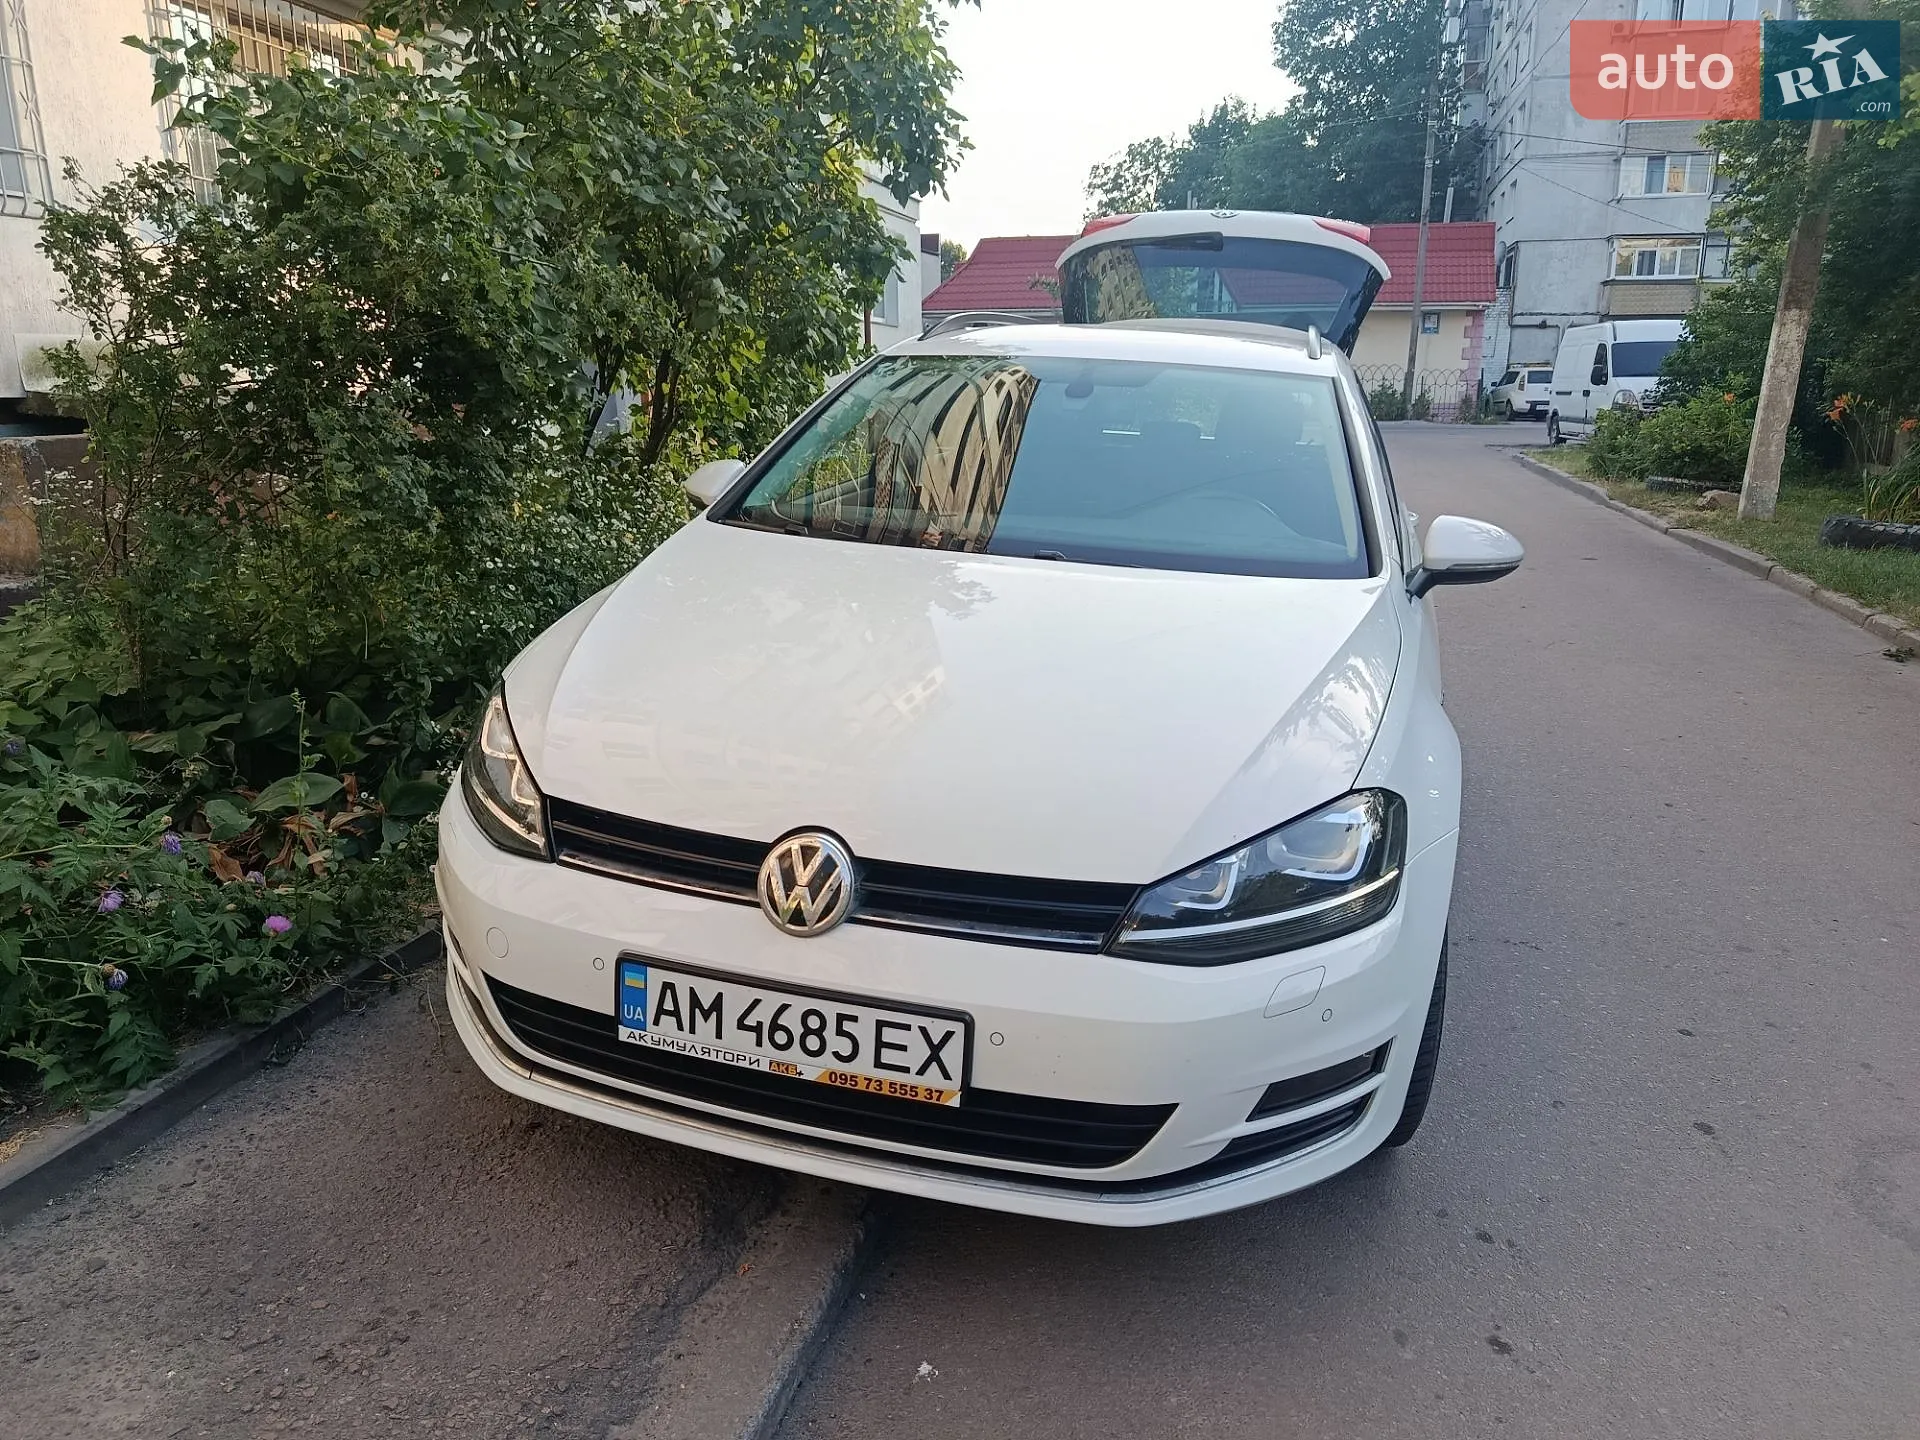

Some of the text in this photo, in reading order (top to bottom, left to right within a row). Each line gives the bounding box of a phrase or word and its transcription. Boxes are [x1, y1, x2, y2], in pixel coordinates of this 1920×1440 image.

[624, 1004, 644, 1022] UA
[652, 981, 956, 1081] AM 4685 EX
[626, 1030, 761, 1068] АКУМУЛЯТОРИ
[828, 1071, 945, 1102] 095 73 555 37
